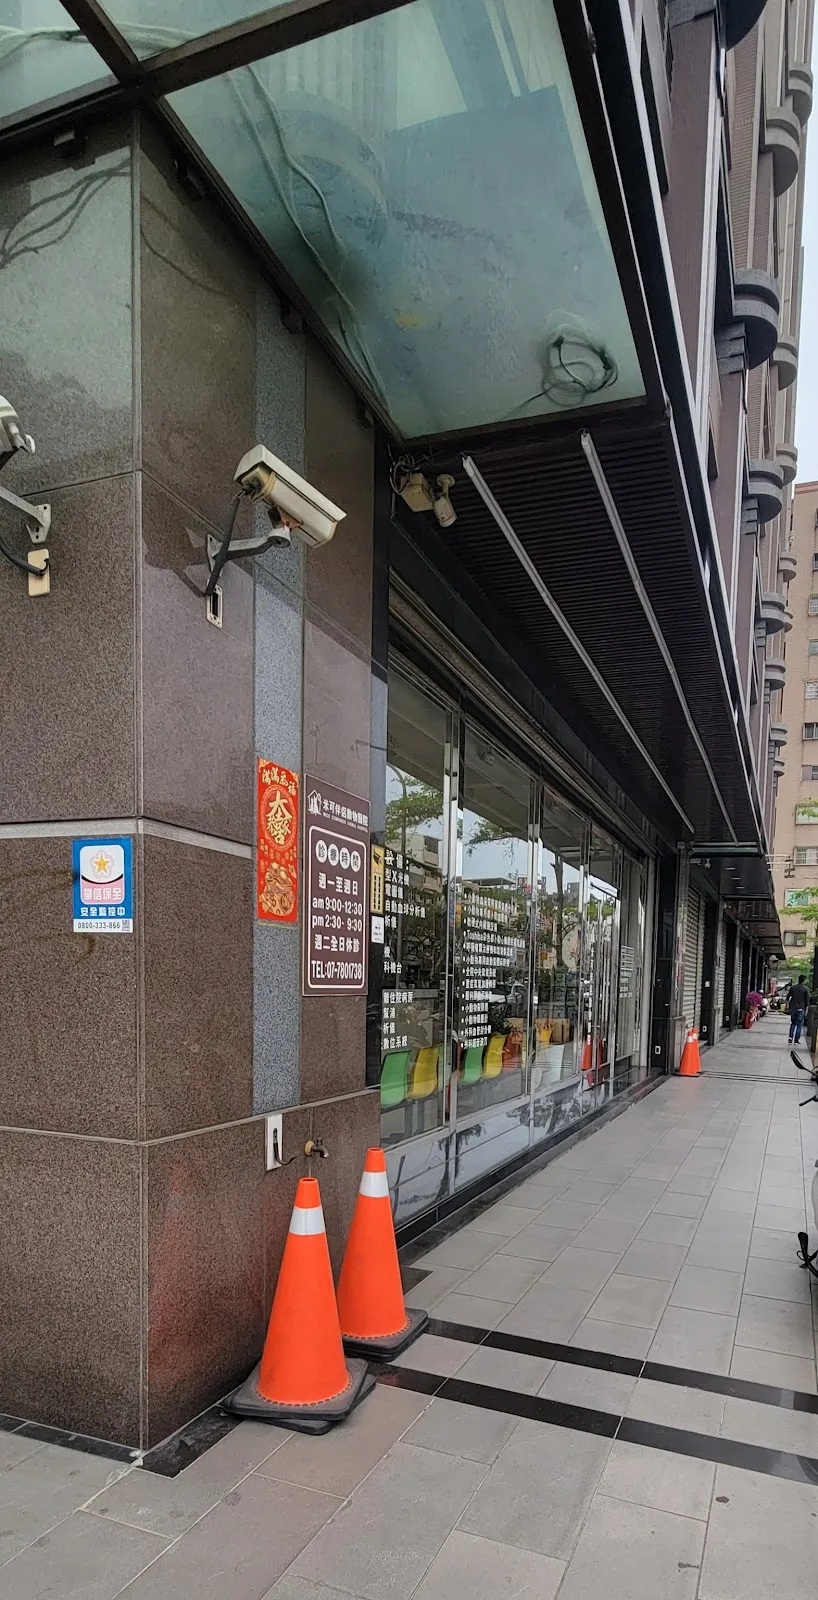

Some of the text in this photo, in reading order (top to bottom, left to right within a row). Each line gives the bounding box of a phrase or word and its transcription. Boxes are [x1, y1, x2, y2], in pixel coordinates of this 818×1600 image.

[318, 872, 358, 896] 週一至週日
[80, 906, 126, 917] 安全監控中
[77, 921, 121, 930] 0800-333-866
[314, 933, 360, 953] 週二全日休診
